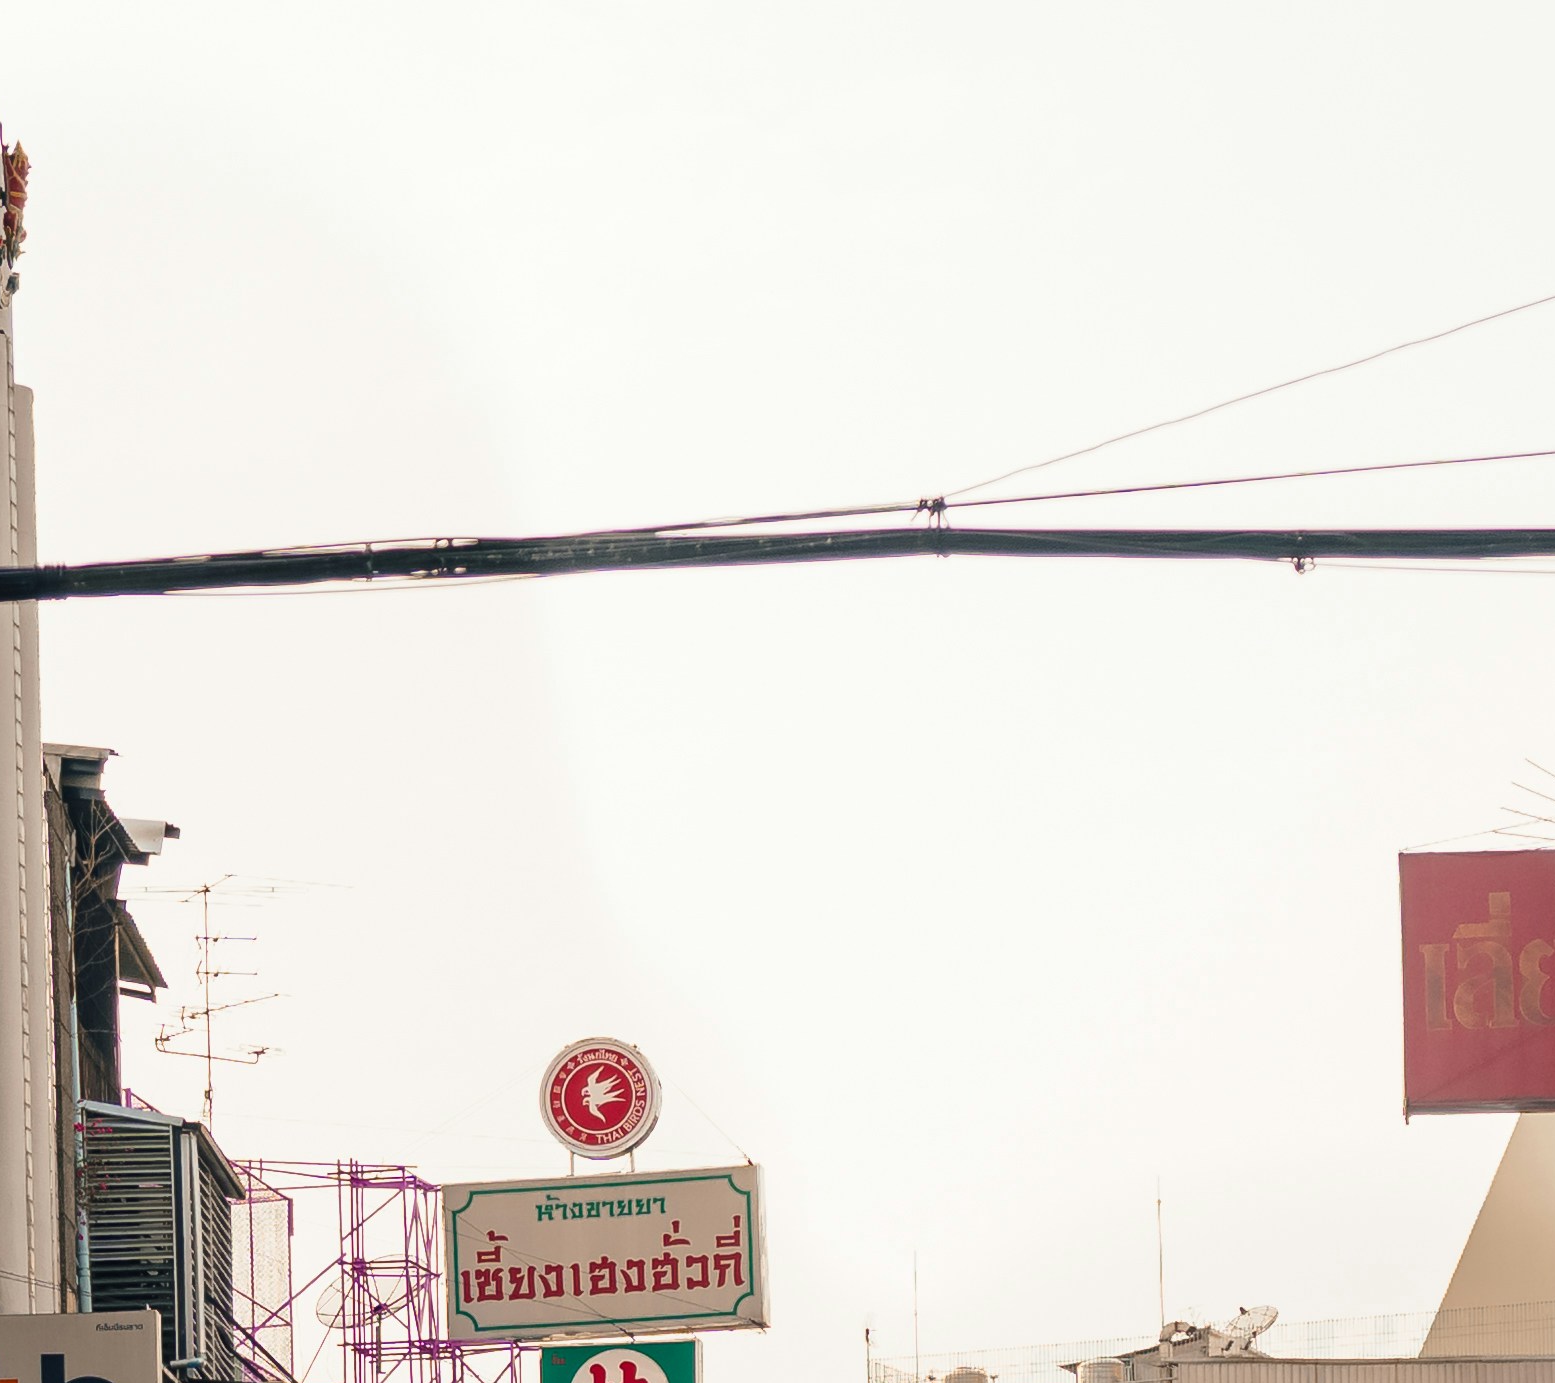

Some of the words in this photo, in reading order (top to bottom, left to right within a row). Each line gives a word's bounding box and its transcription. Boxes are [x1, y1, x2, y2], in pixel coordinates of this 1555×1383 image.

[628, 1067, 646, 1097] NEST
[623, 1099, 646, 1132] BIRDS
[595, 1126, 626, 1144] THAI
[535, 1194, 667, 1222] ห้างขายยา
